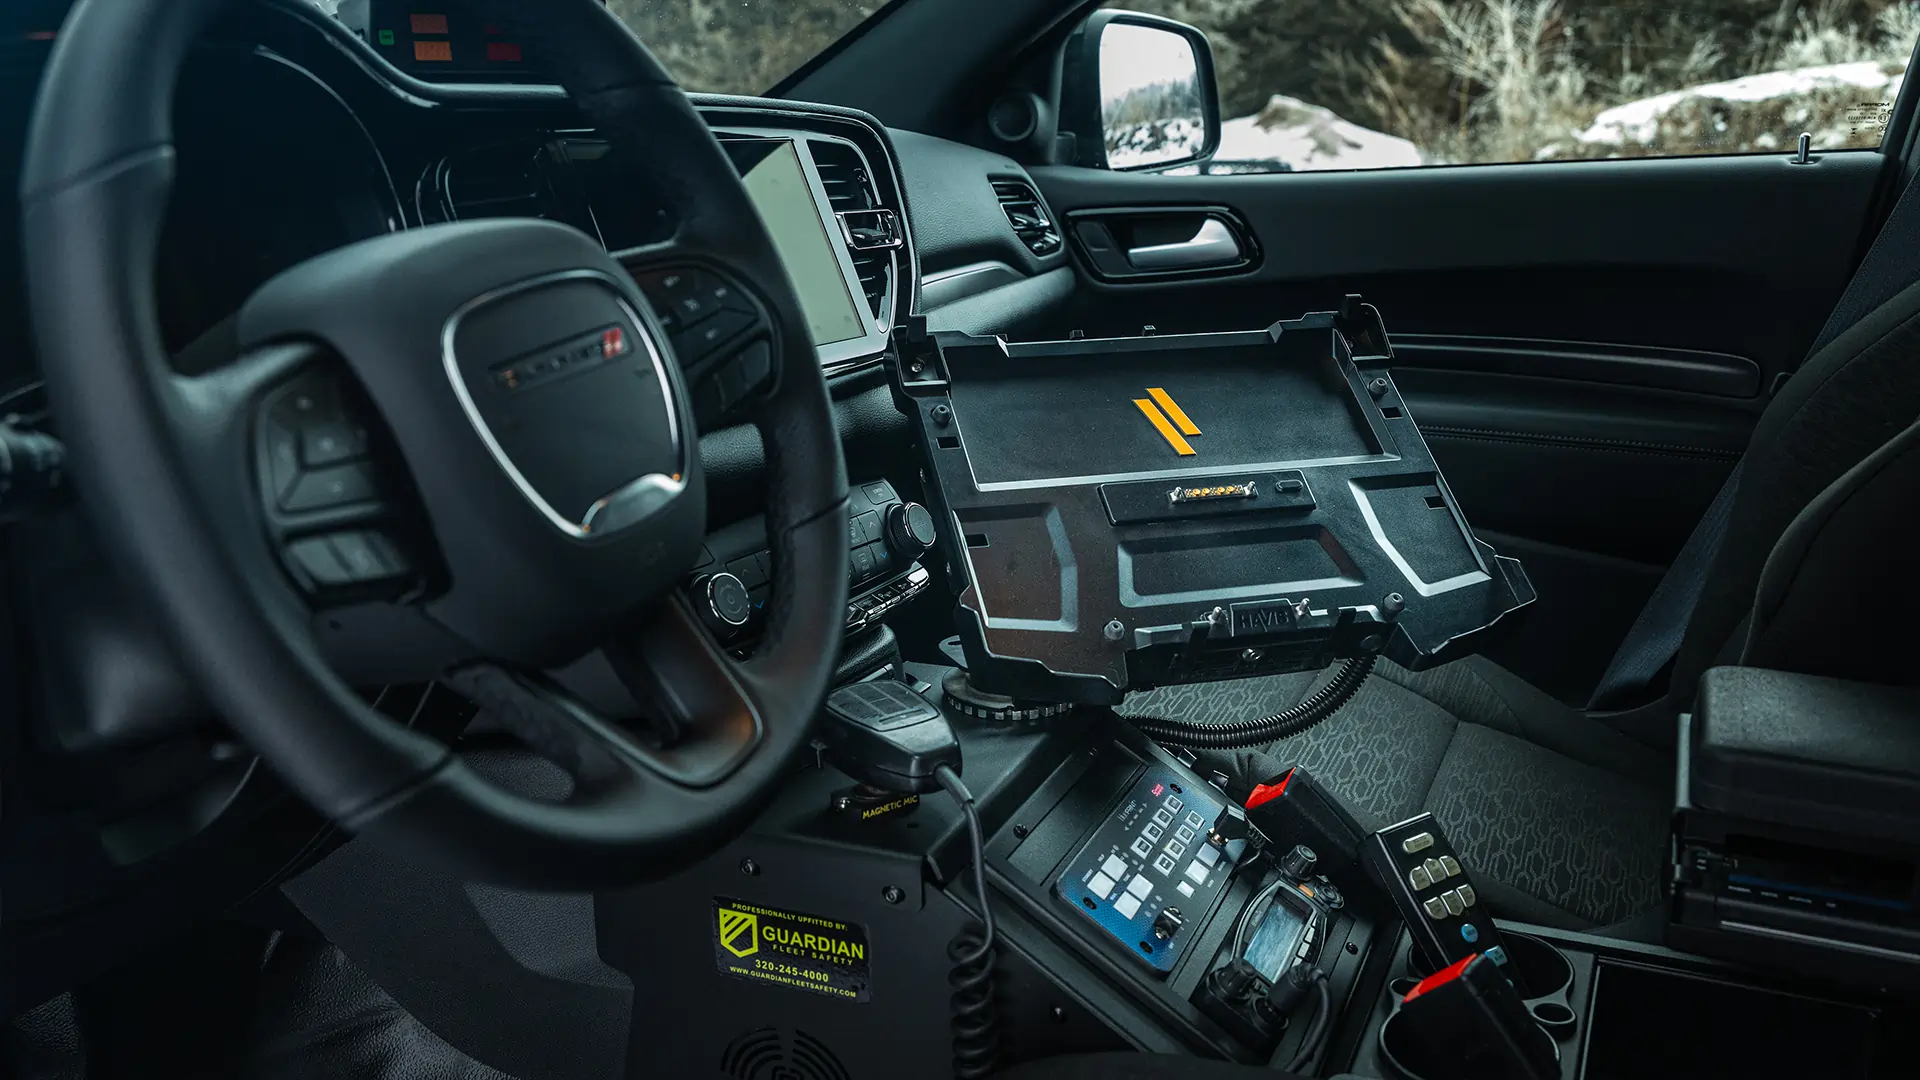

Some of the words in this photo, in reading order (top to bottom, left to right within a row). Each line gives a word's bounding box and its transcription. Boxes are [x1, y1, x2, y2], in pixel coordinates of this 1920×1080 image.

[1239, 608, 1289, 632] HAVIS
[862, 800, 902, 819] MAGNETIC
[903, 795, 918, 806] MIC
[732, 902, 796, 921] PROFESSIONALLY
[798, 915, 834, 929] UPFITTED
[835, 922, 848, 931] BY:
[762, 925, 864, 960] GUARDIAN
[773, 944, 805, 956] FLEET
[811, 952, 853, 966] SAFETY
[730, 966, 857, 998] WWW.GUARDIANFLEETSAFETY.COM
[755, 959, 829, 982] 320-245-4000
